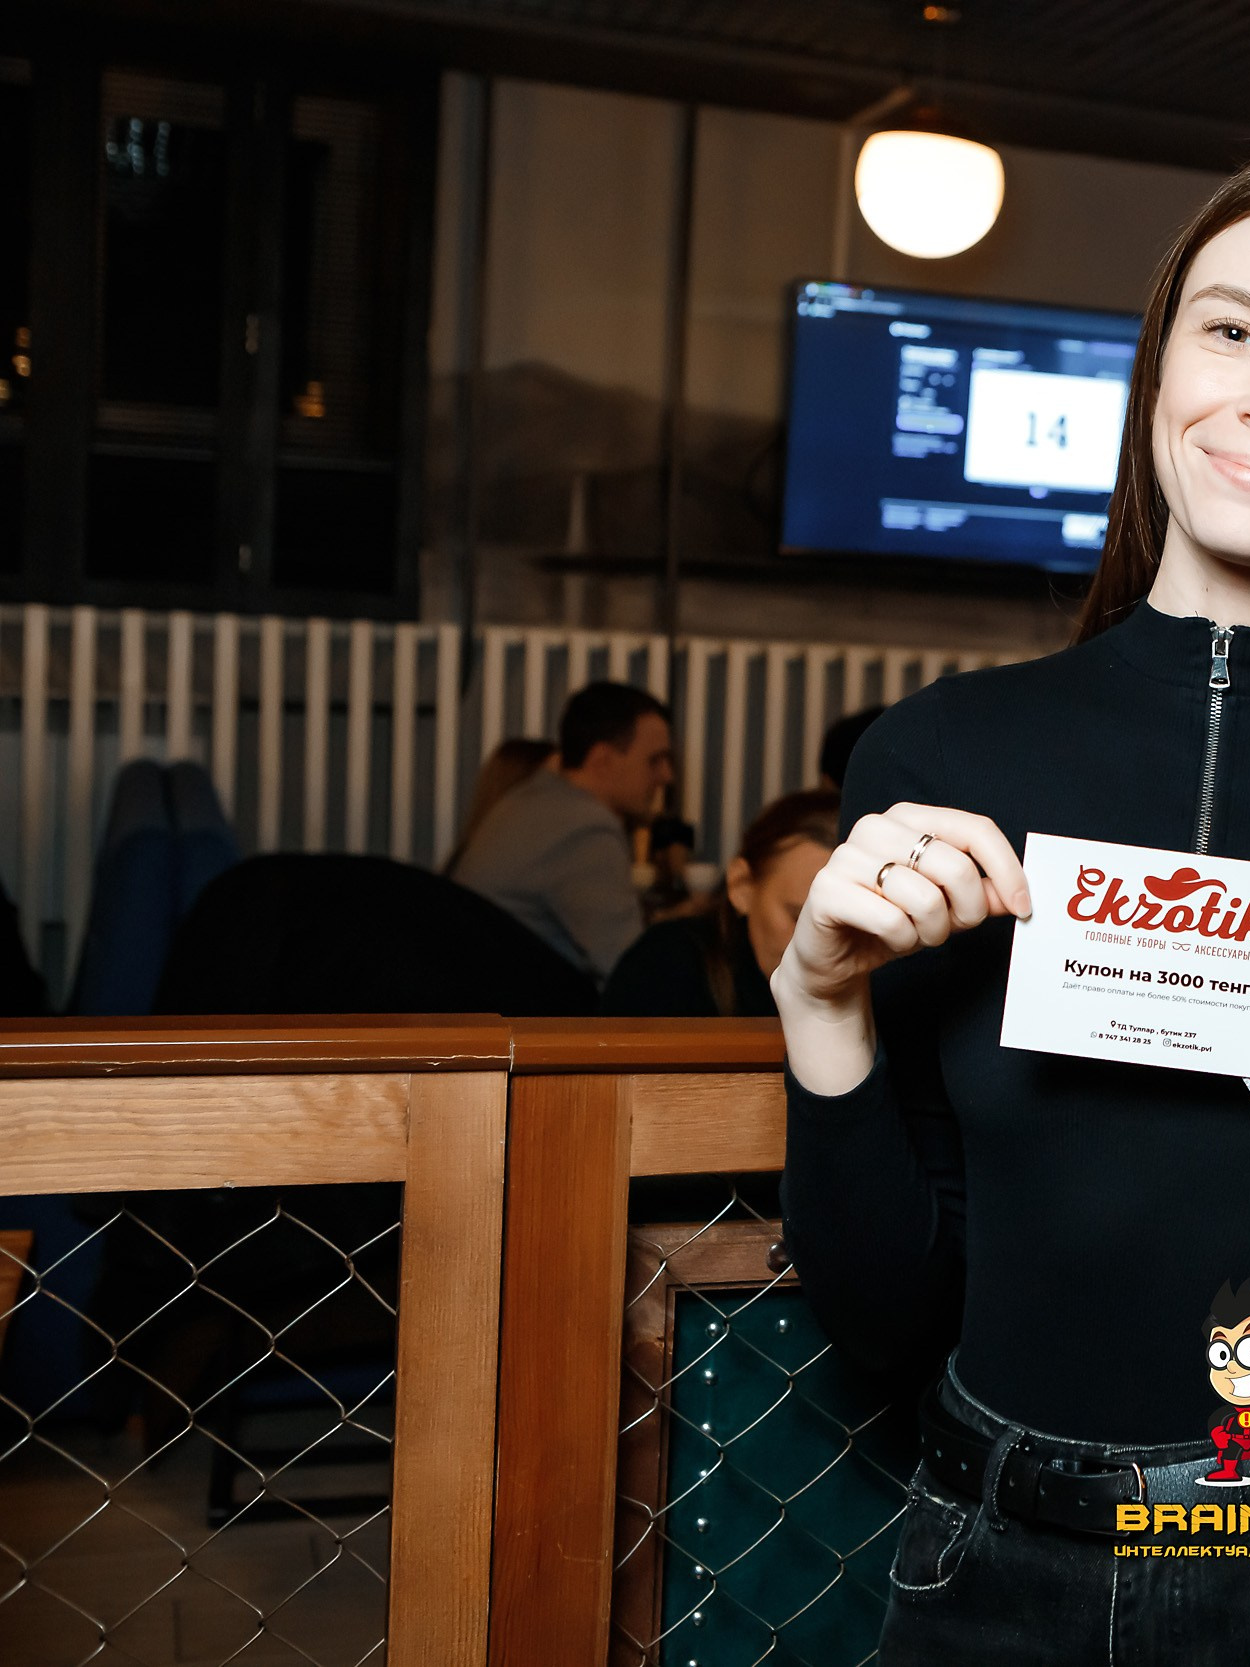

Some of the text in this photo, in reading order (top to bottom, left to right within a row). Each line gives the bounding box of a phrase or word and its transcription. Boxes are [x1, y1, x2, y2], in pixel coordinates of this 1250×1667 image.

[1026, 411, 1068, 449] 14
[1085, 930, 1250, 960] ГОЛОВНЫЕ УБОРЫ АКСЕССУАРЫ
[1064, 959, 1124, 979] Купон
[1129, 970, 1152, 982] на
[1156, 970, 1204, 989] 3000
[1082, 984, 1106, 993] право
[1107, 988, 1134, 996] оплаты
[1147, 991, 1170, 1001] более
[1171, 995, 1187, 1003] 50%
[1188, 998, 1228, 1008] стоимости
[1129, 1024, 1155, 1034] Тулпар
[1160, 1028, 1182, 1037] бутик
[1184, 1031, 1197, 1039] 237
[1172, 1042, 1212, 1052] ekzotik.pvl
